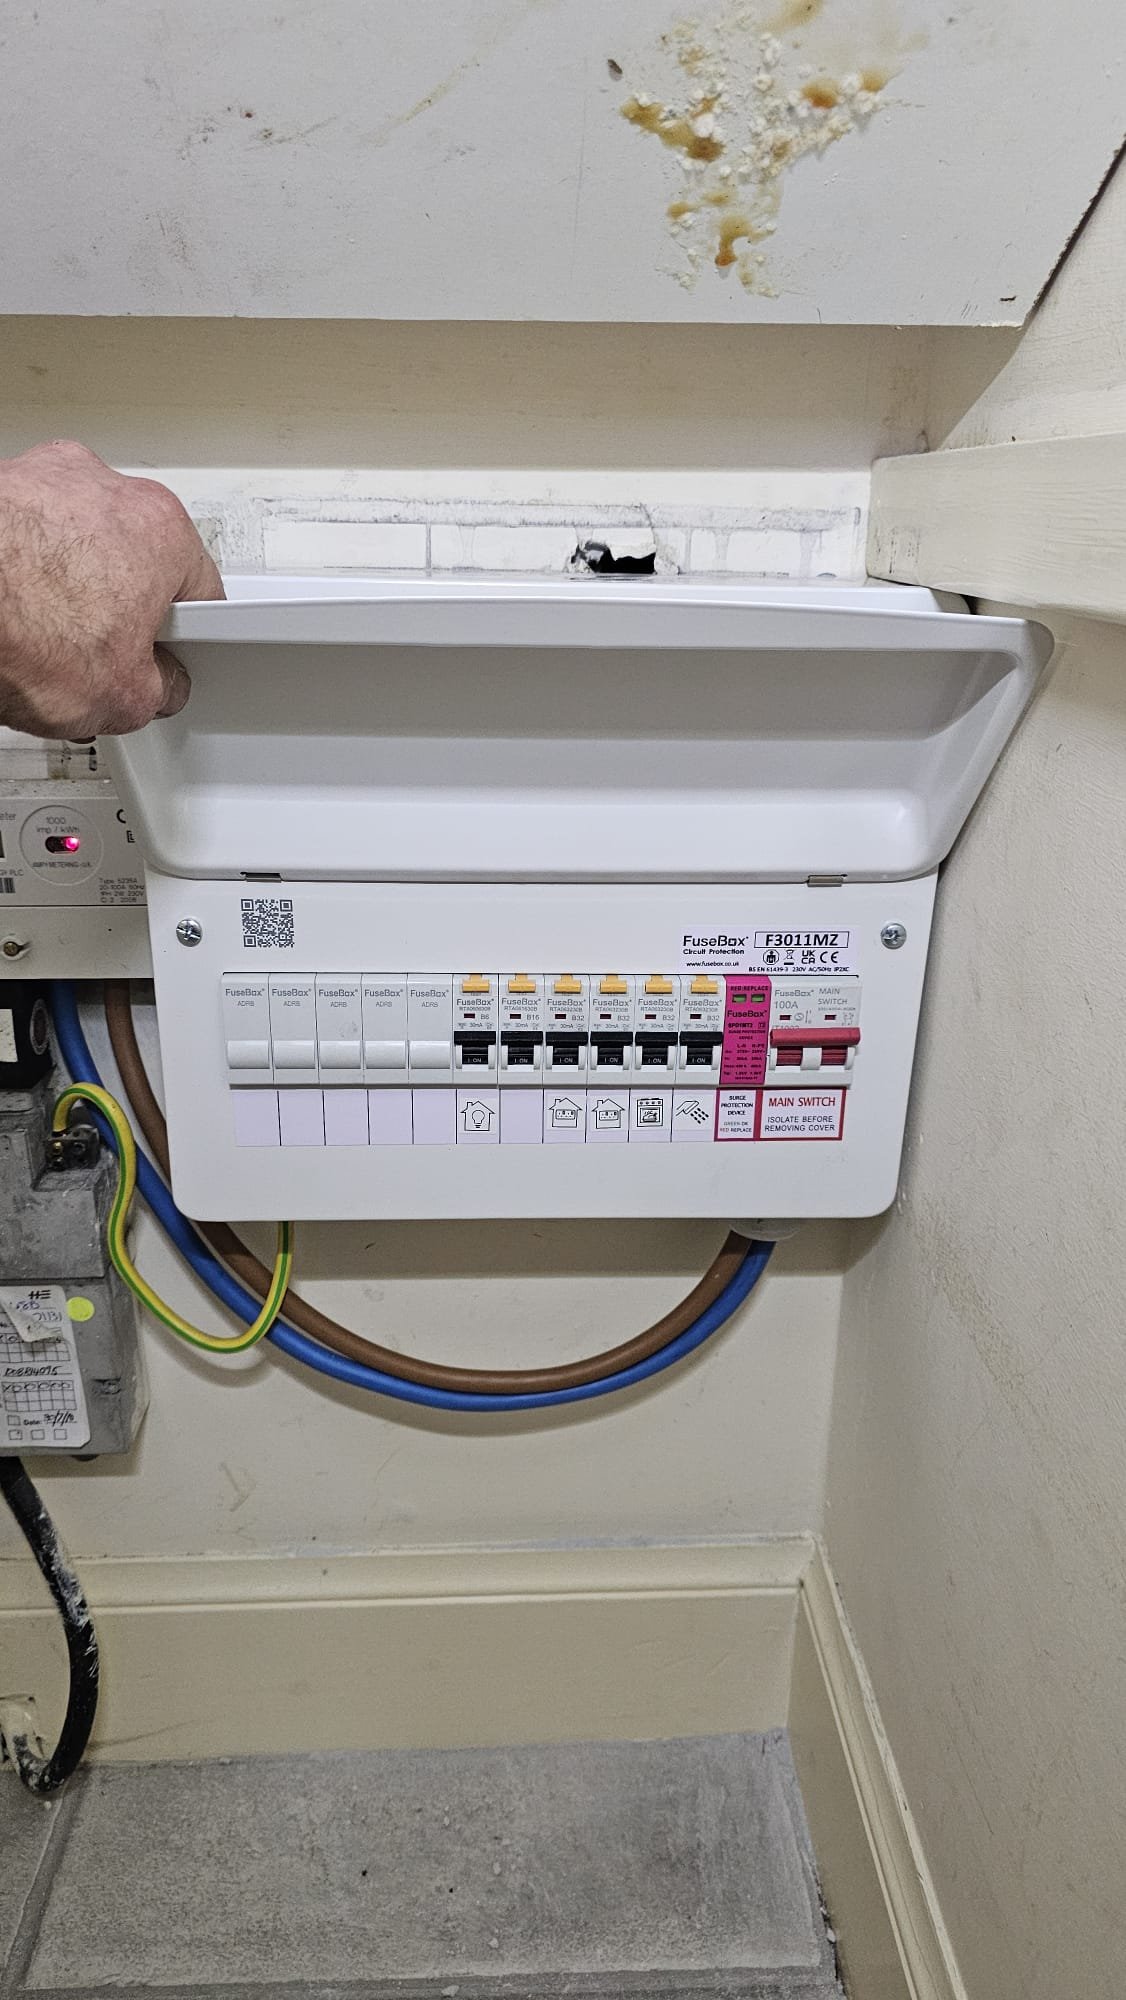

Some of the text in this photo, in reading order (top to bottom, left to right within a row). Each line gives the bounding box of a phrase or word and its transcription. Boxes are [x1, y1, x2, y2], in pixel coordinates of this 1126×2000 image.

[683, 934, 839, 946] FuseBox F3011MZ
[775, 1001, 798, 1009] 100A
[768, 1096, 836, 1107] MAIN SWITCH
[767, 1115, 833, 1124] ISOLATE BEFORE
[764, 1124, 835, 1132] REMOVING COVER
